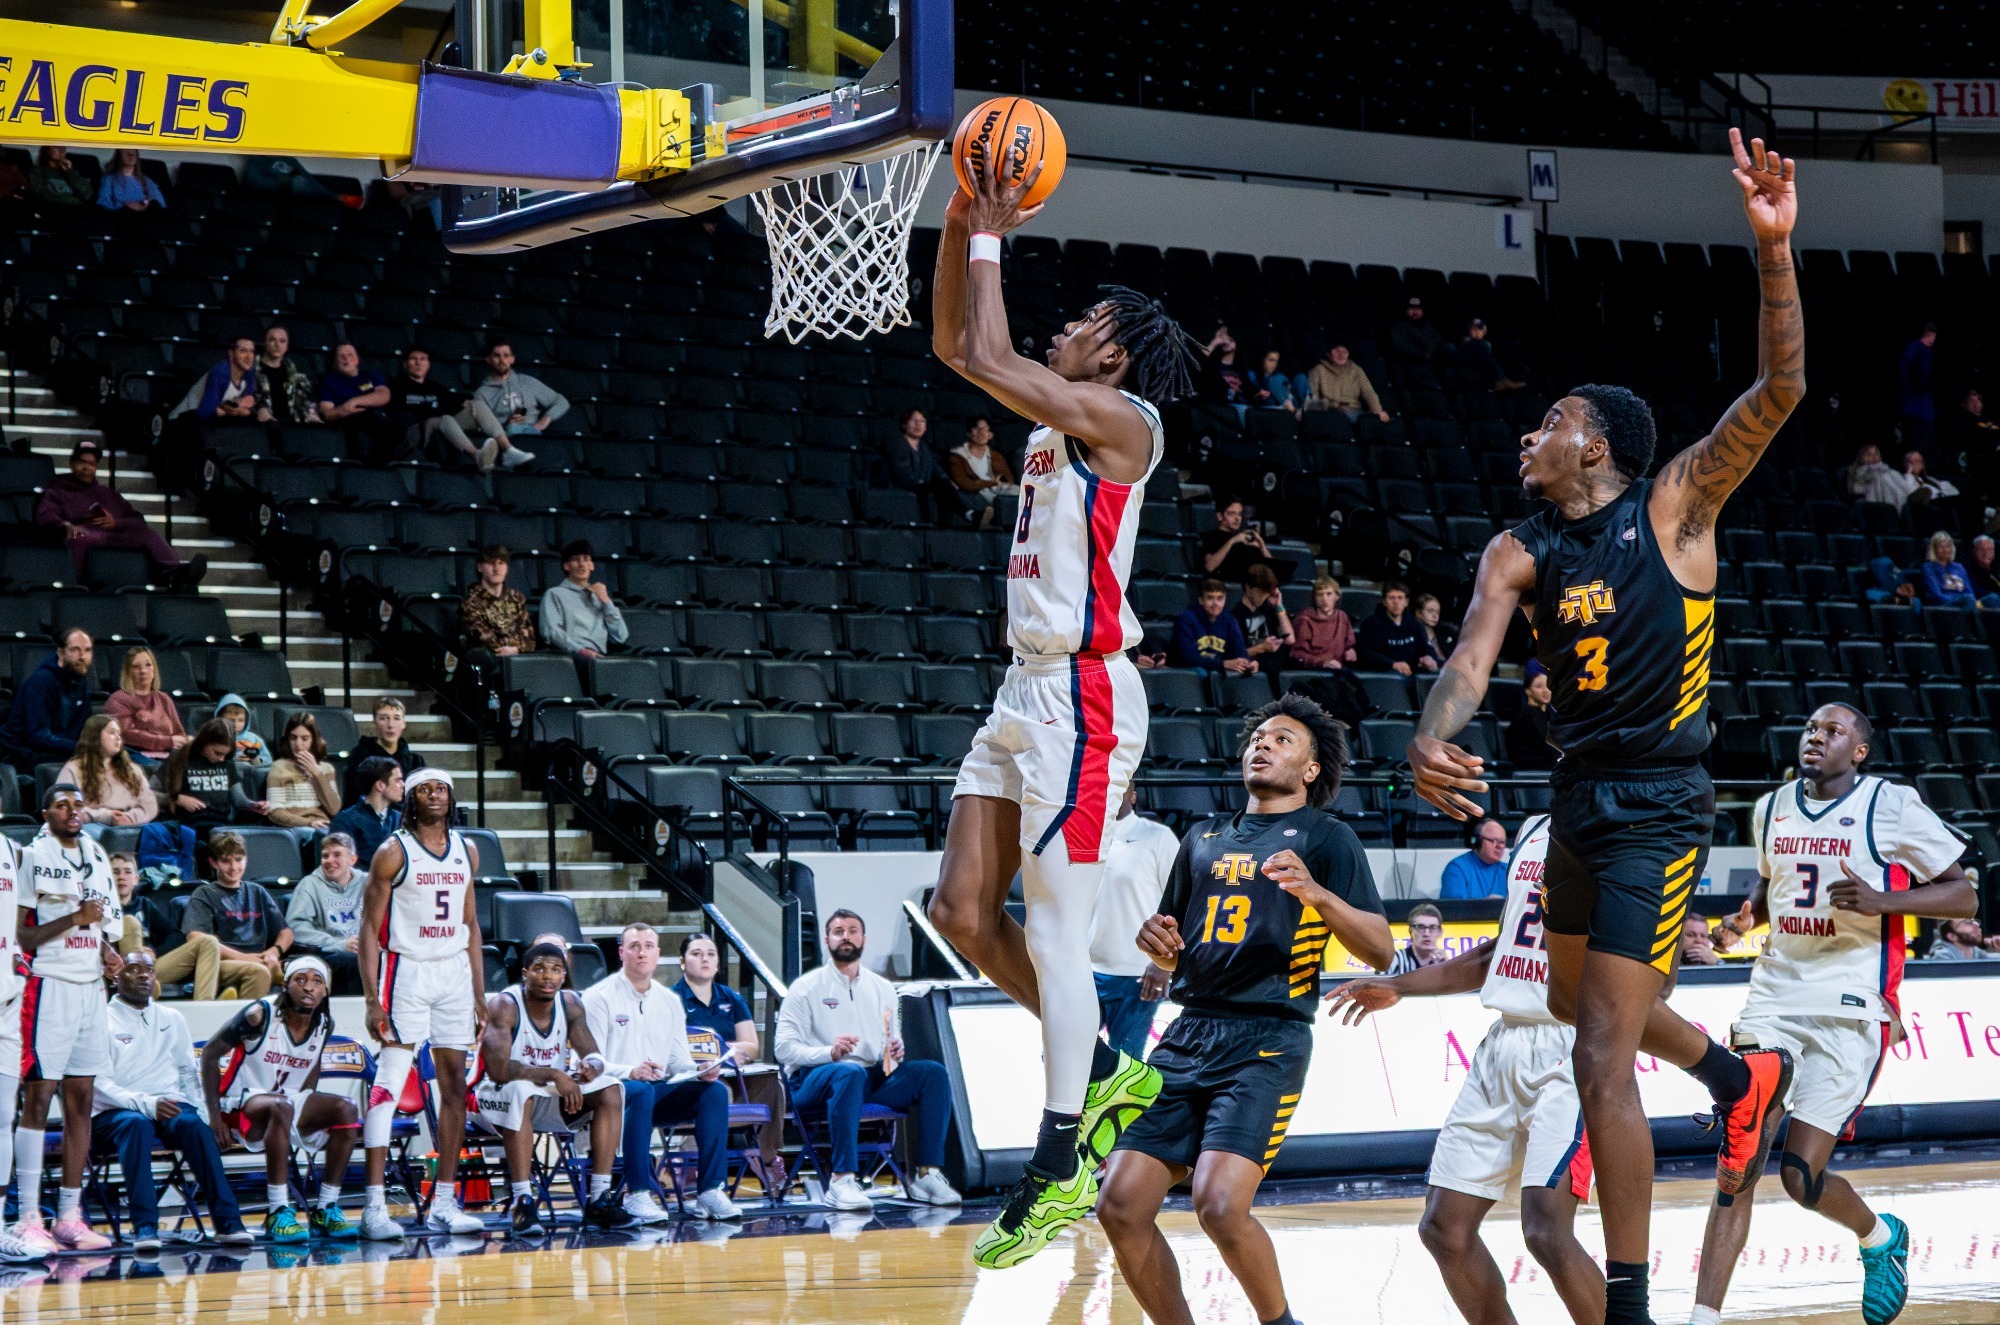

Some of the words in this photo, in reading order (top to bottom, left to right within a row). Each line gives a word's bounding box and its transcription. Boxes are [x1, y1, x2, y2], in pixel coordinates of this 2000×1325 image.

[0, 56, 249, 143] AGLES
[1533, 164, 1554, 188] M
[1504, 213, 1521, 249] L
[1557, 580, 1617, 627] TTU
[1574, 636, 1610, 691] 3
[187, 775, 229, 791] TECH
[1773, 837, 1852, 857] SOUTHERN
[416, 872, 464, 885] SOUTHERN
[1211, 853, 1258, 886] TTU
[1794, 863, 1819, 909] 3
[435, 890, 449, 921] 5
[1201, 894, 1252, 944] 13
[1496, 955, 1549, 985] INDIAN
[263, 1050, 312, 1069] SOUTHERN
